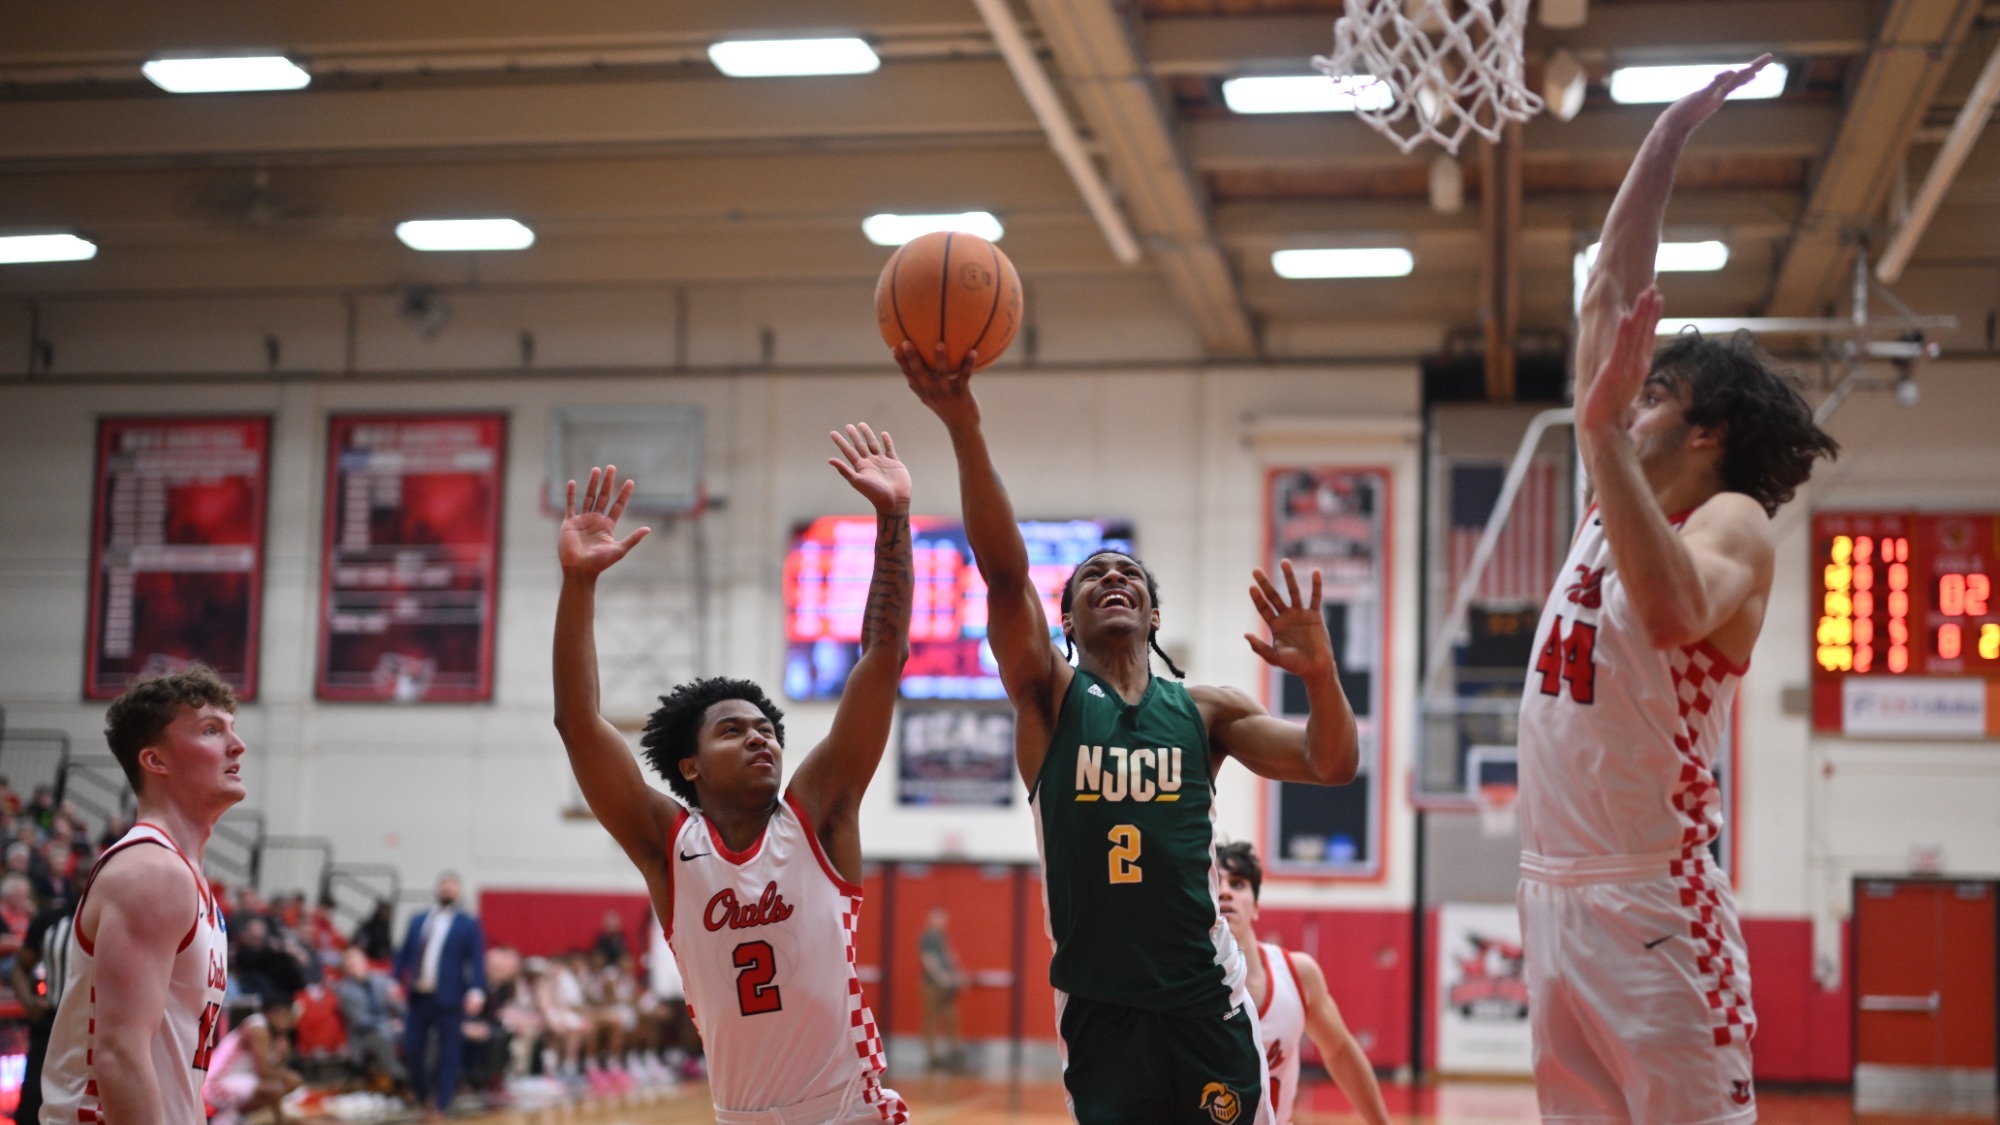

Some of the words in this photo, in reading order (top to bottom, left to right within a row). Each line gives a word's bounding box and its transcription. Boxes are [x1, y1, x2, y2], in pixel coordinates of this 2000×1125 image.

[1535, 614, 1597, 704] 44
[1075, 744, 1182, 803] NJCU
[1107, 823, 1143, 885] 2
[703, 880, 795, 932] Owls
[732, 940, 783, 1017] 2
